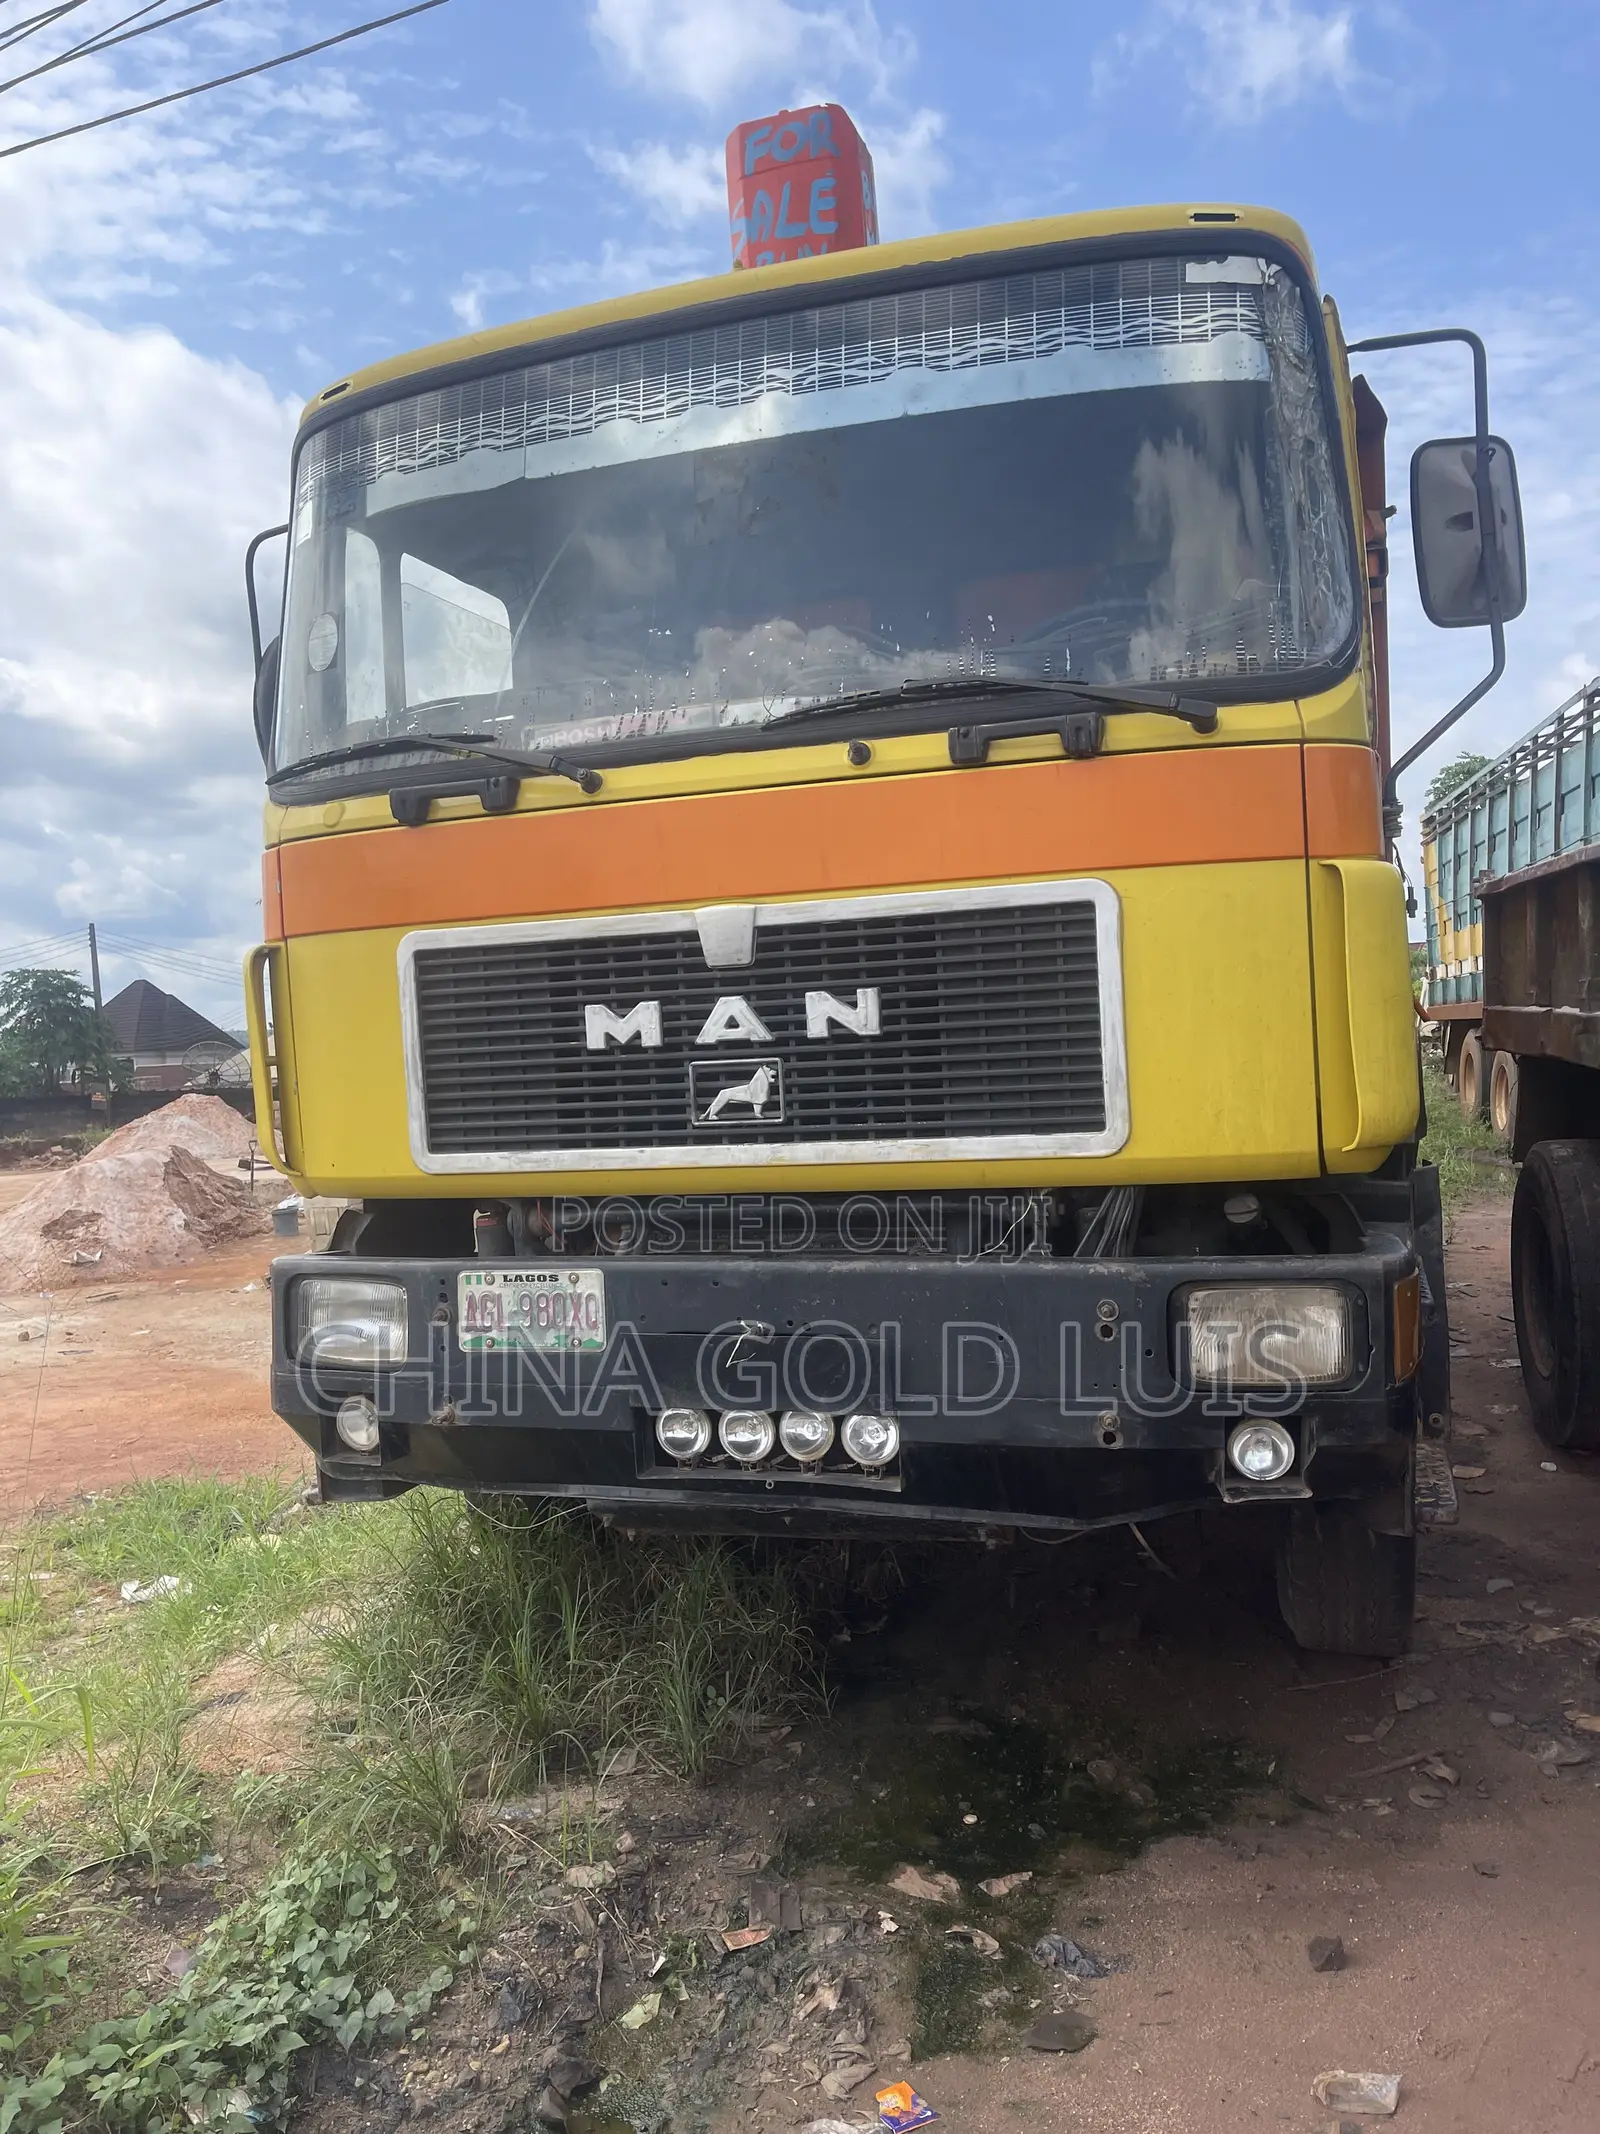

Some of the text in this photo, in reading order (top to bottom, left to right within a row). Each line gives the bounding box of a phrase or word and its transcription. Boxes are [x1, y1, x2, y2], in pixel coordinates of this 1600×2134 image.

[744, 111, 841, 176] FOR
[731, 171, 838, 260] SALE
[584, 987, 881, 1050] MAN
[502, 1274, 560, 1283] LAGOS
